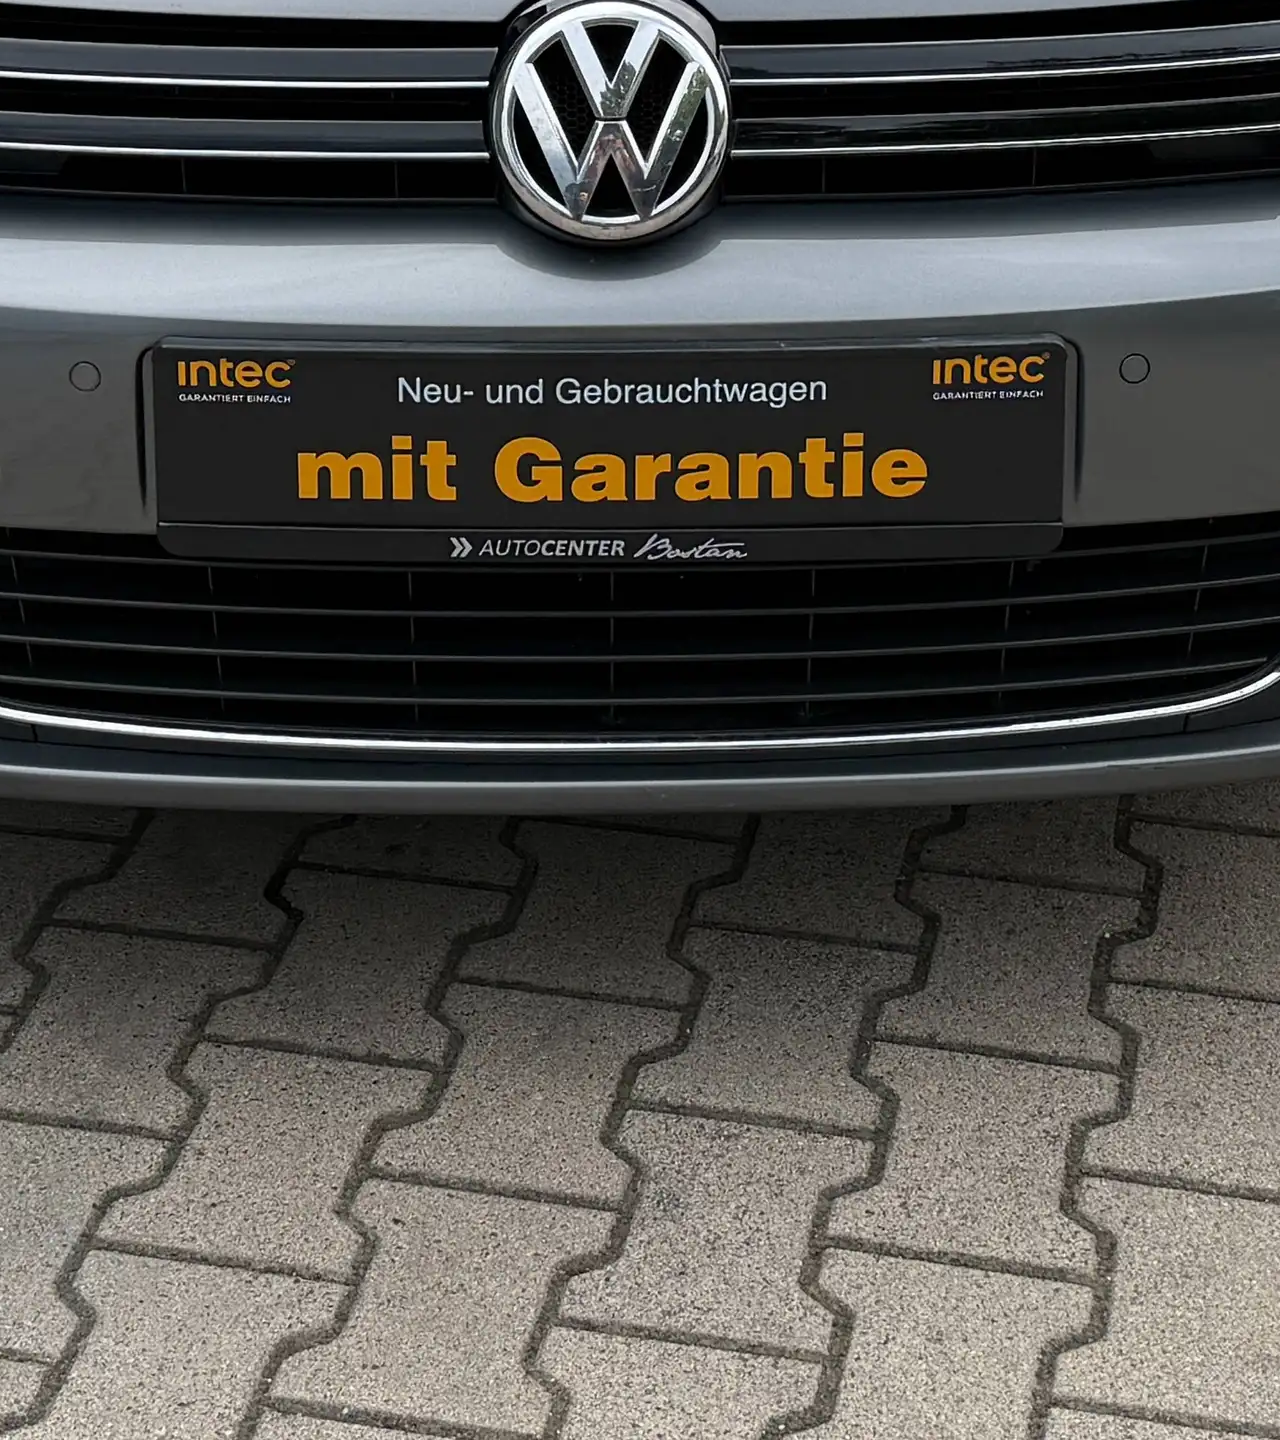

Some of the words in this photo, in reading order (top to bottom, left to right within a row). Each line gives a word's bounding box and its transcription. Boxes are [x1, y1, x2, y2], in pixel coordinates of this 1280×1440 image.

[178, 358, 292, 389] intec
[932, 354, 1045, 385] intec
[178, 393, 244, 403] GARANTIERT
[246, 394, 291, 404] EINFACH
[397, 376, 474, 404] Neu-
[485, 378, 544, 404] und
[555, 377, 827, 409] Gebrauchtwagen
[932, 391, 997, 401] GARANTIERT
[999, 389, 1044, 399] EINFACH
[297, 435, 457, 500] mit
[494, 432, 928, 502] Garantie
[478, 539, 625, 557] AUTOCENTER
[633, 533, 748, 561] Bostan
